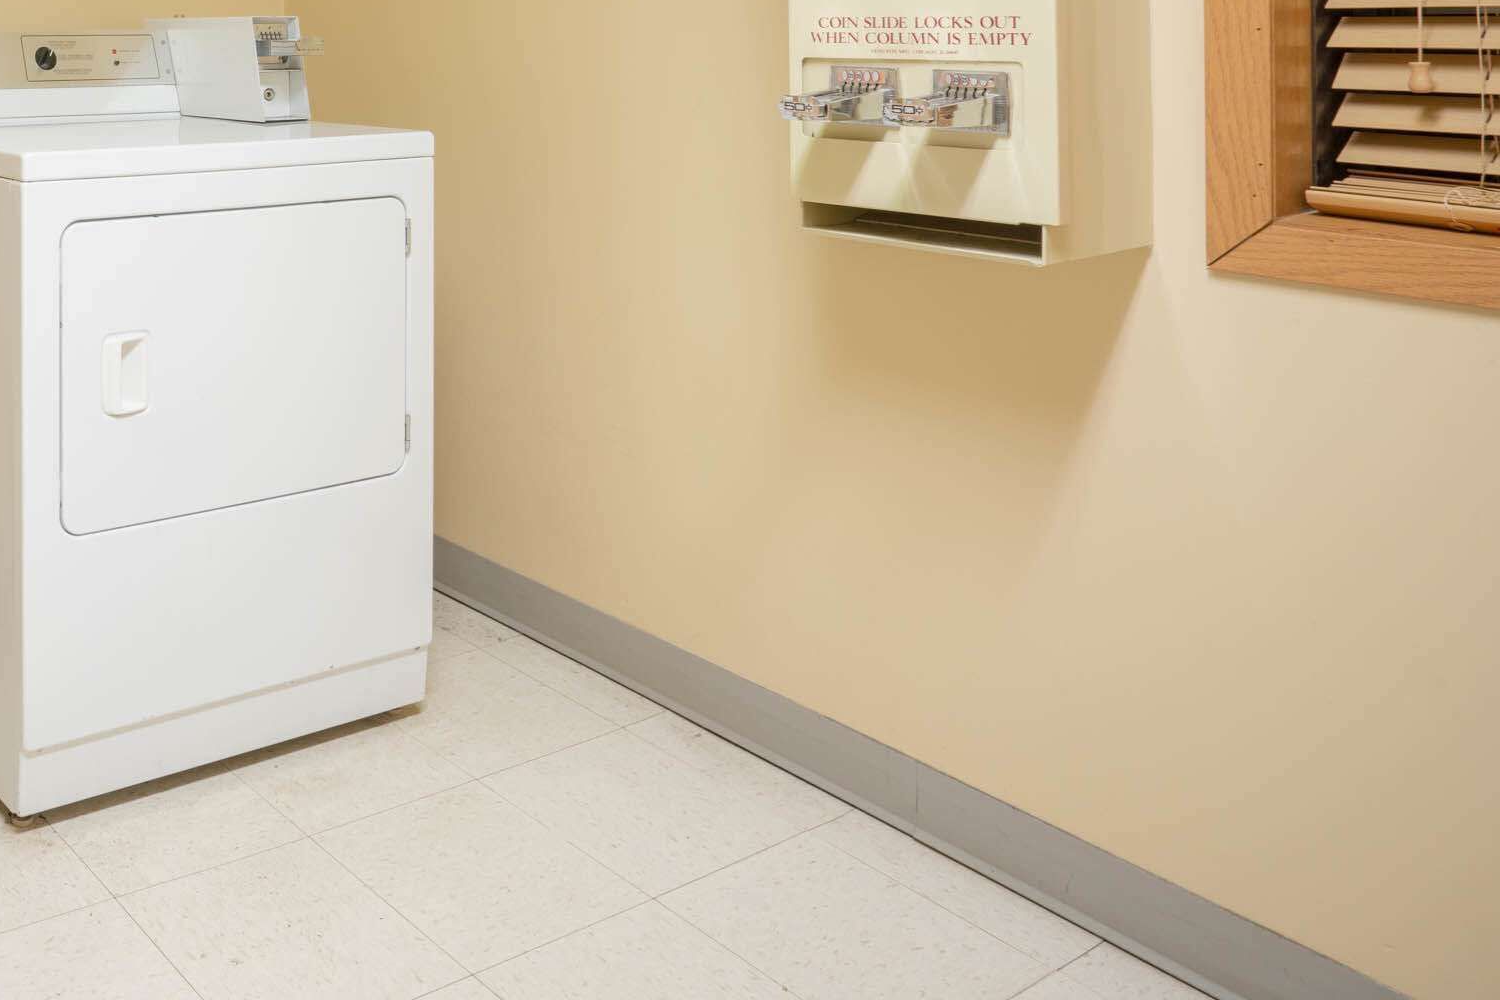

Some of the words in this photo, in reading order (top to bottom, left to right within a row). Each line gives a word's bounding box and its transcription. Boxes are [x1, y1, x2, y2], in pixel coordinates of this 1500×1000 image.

[818, 16, 858, 28] COIN
[863, 16, 908, 29] SLIDE
[914, 16, 973, 29] LOCKS
[979, 16, 1021, 29] OUT
[811, 32, 858, 44] WHEN
[865, 32, 940, 45] COLUMN
[947, 33, 961, 45] IS
[969, 32, 1031, 46] EMPTY
